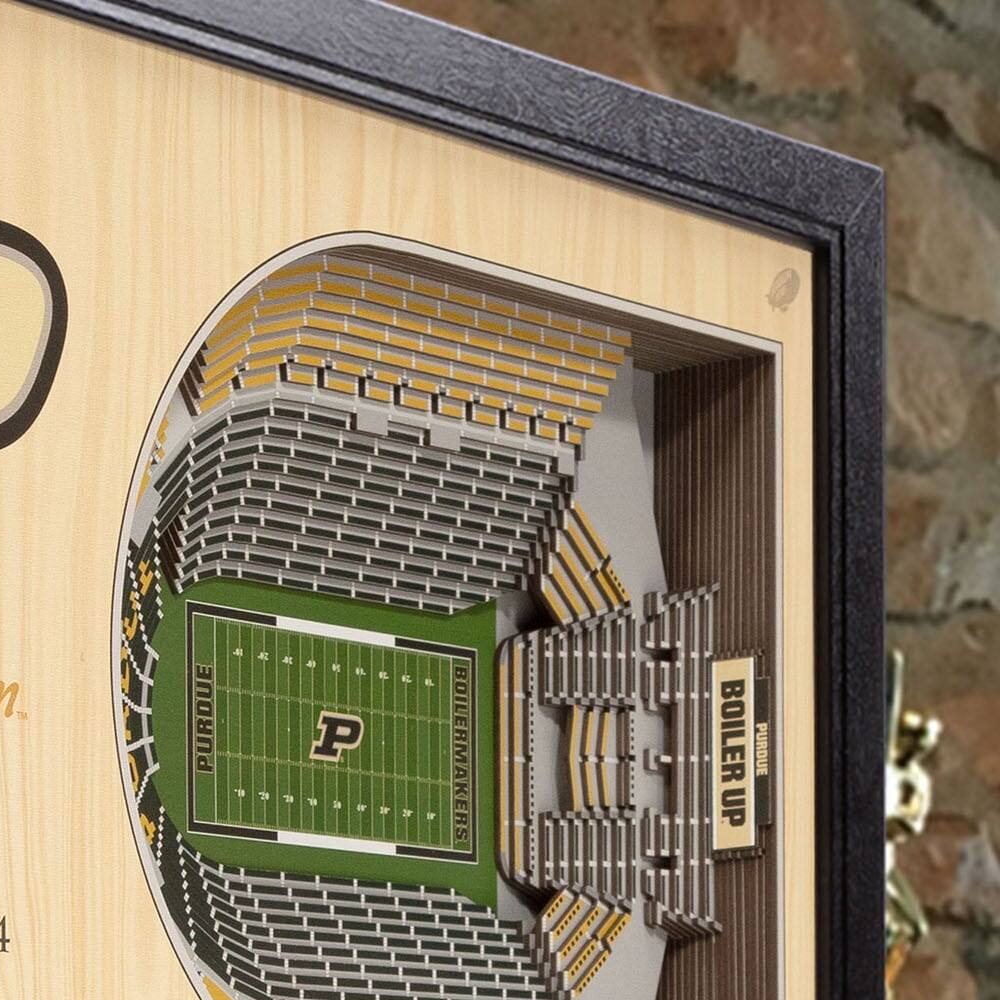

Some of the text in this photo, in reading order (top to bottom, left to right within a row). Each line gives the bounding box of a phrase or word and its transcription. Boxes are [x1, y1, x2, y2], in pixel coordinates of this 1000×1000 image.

[195, 662, 214, 775] PURDUE
[309, 710, 364, 762] P
[453, 664, 469, 842] BOILERMAKERS
[720, 678, 746, 827] BOILER UP
[756, 722, 768, 777] PURDUE
